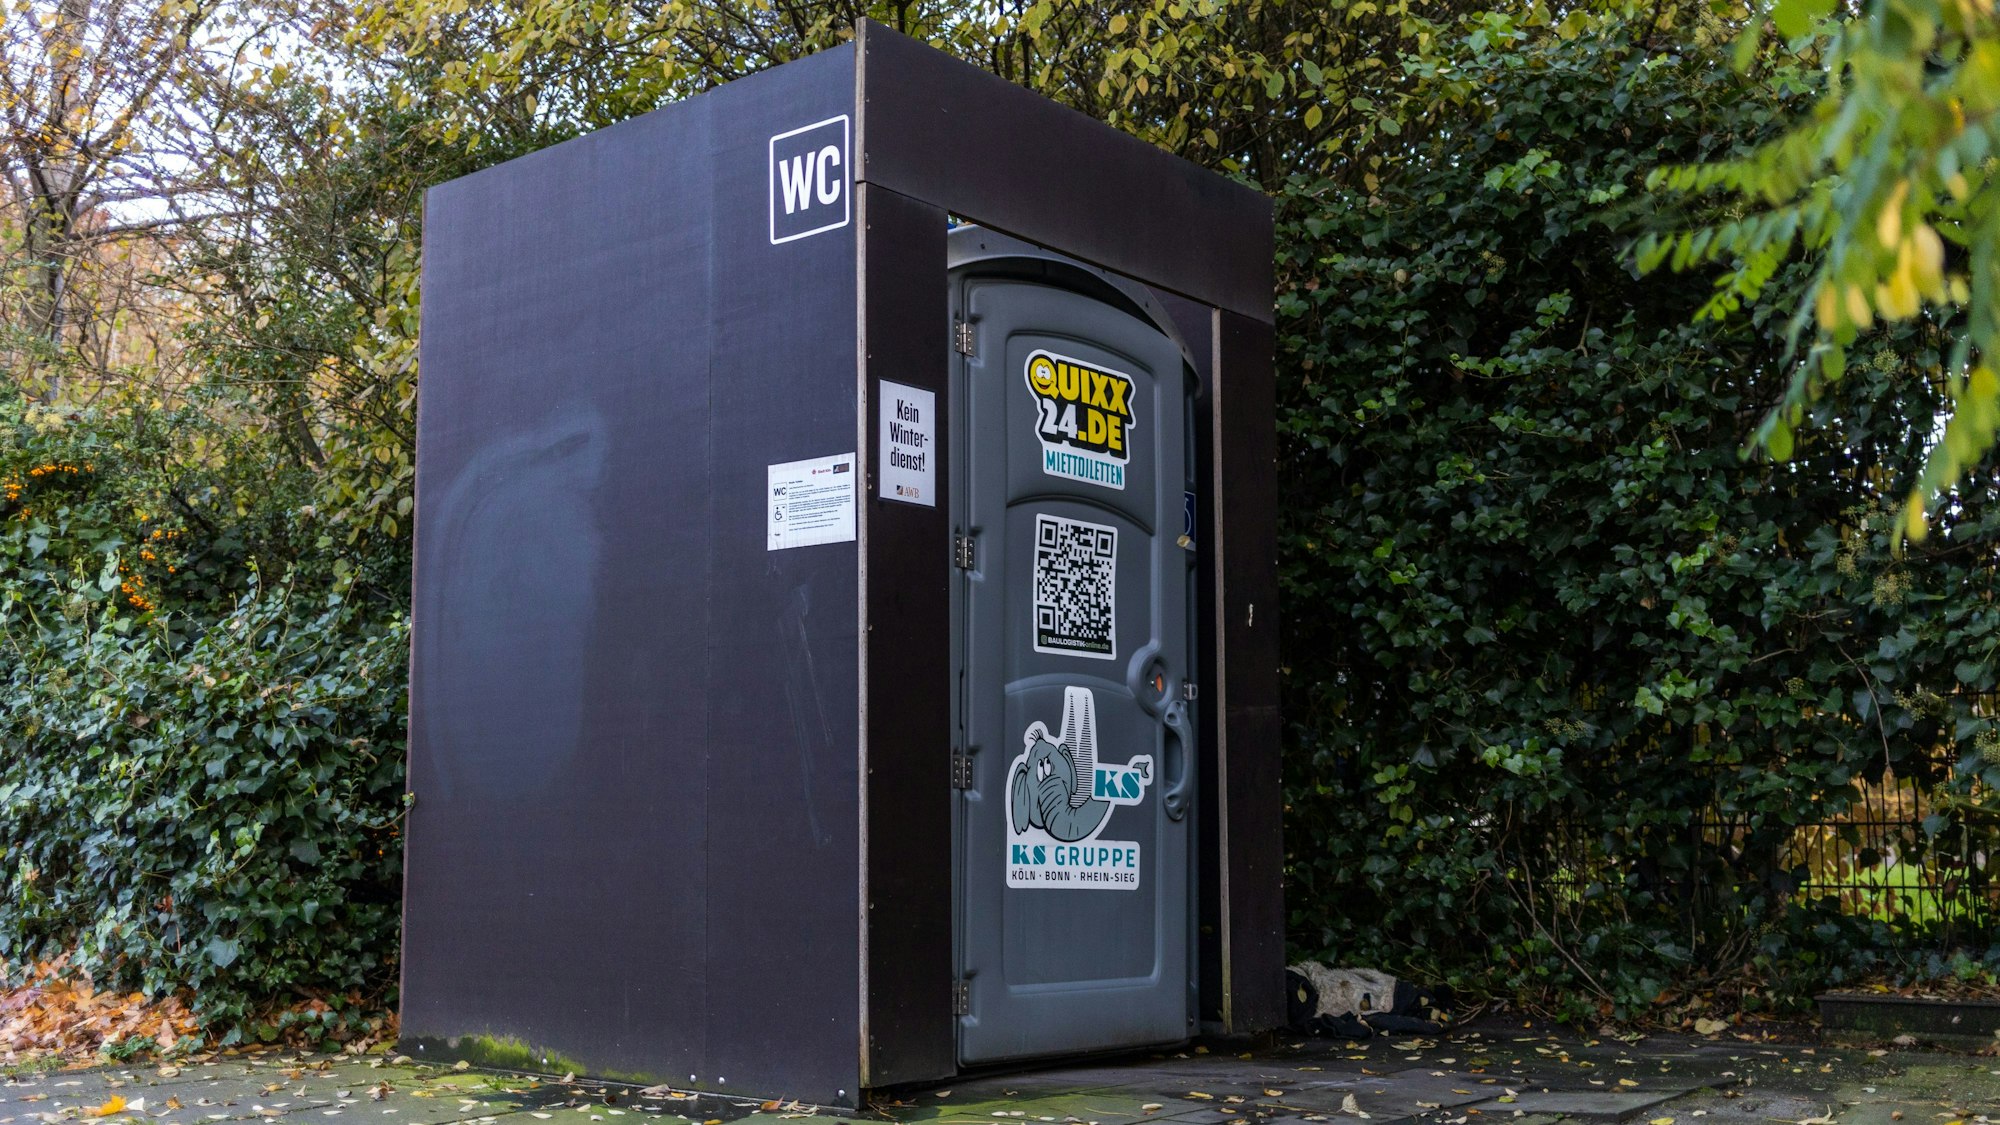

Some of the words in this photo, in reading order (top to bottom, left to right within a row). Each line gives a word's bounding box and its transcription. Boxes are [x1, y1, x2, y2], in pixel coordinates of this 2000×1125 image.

[779, 145, 840, 214] WC
[1029, 356, 1128, 416] QUIXX
[896, 398, 919, 423] Kein
[889, 421, 929, 448] Winter-
[1040, 397, 1122, 451] 24.DE
[890, 446, 925, 472] dienst!
[1045, 449, 1122, 486] MIETTOILETTEN
[773, 487, 786, 496] WC
[904, 486, 919, 499] AWB
[1094, 769, 1140, 799] KS
[1012, 844, 1046, 865] KS
[1054, 845, 1136, 868] GRUPPE
[1011, 868, 1036, 881] KÖLN
[1045, 870, 1070, 881] BONN
[1080, 871, 1135, 883] RHEIN-SIEG
